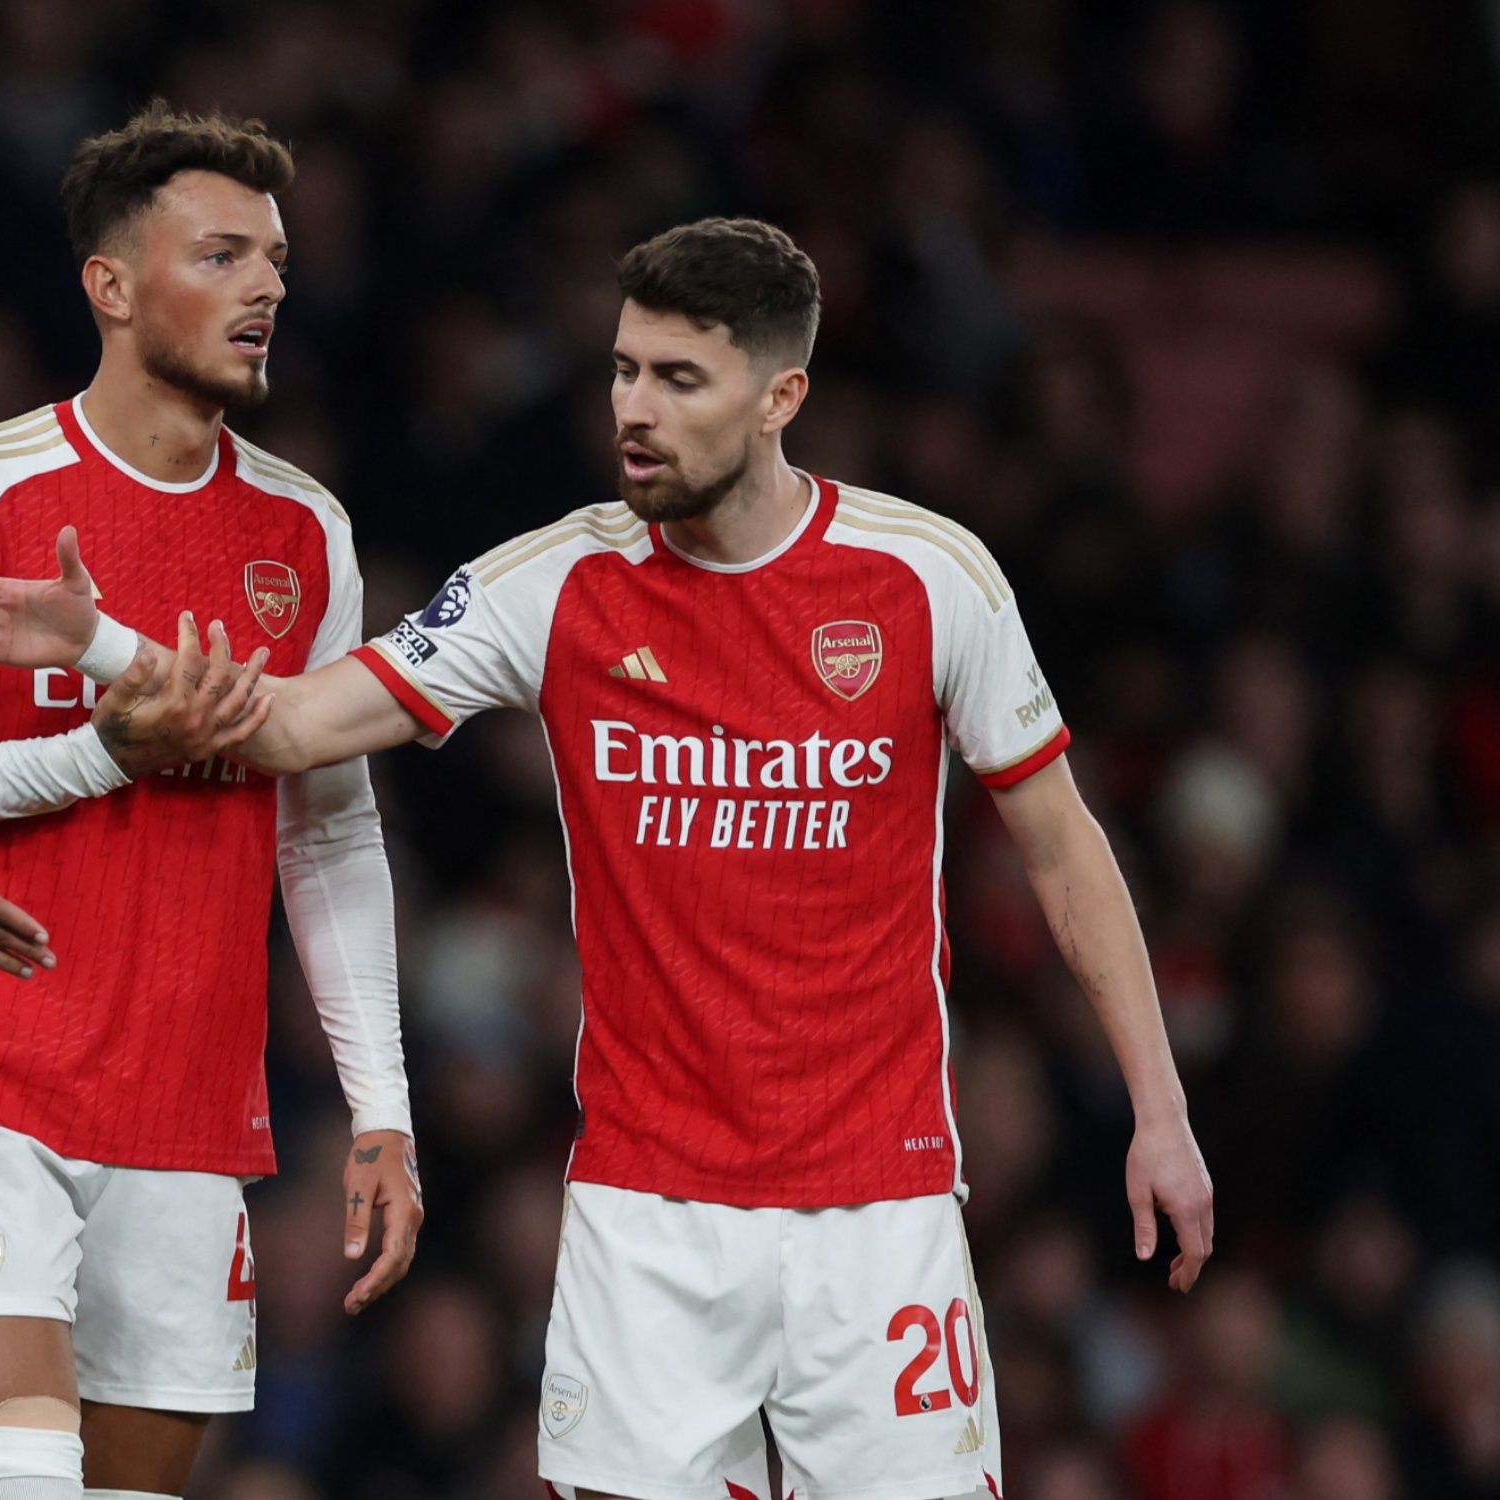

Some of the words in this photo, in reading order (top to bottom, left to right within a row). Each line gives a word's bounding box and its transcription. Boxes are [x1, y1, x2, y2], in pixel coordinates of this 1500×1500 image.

[822, 633, 872, 649] Arsenal
[590, 720, 893, 789] Emirates
[636, 796, 700, 847] FLY
[710, 799, 850, 849] BETTER
[886, 1297, 979, 1417] 20
